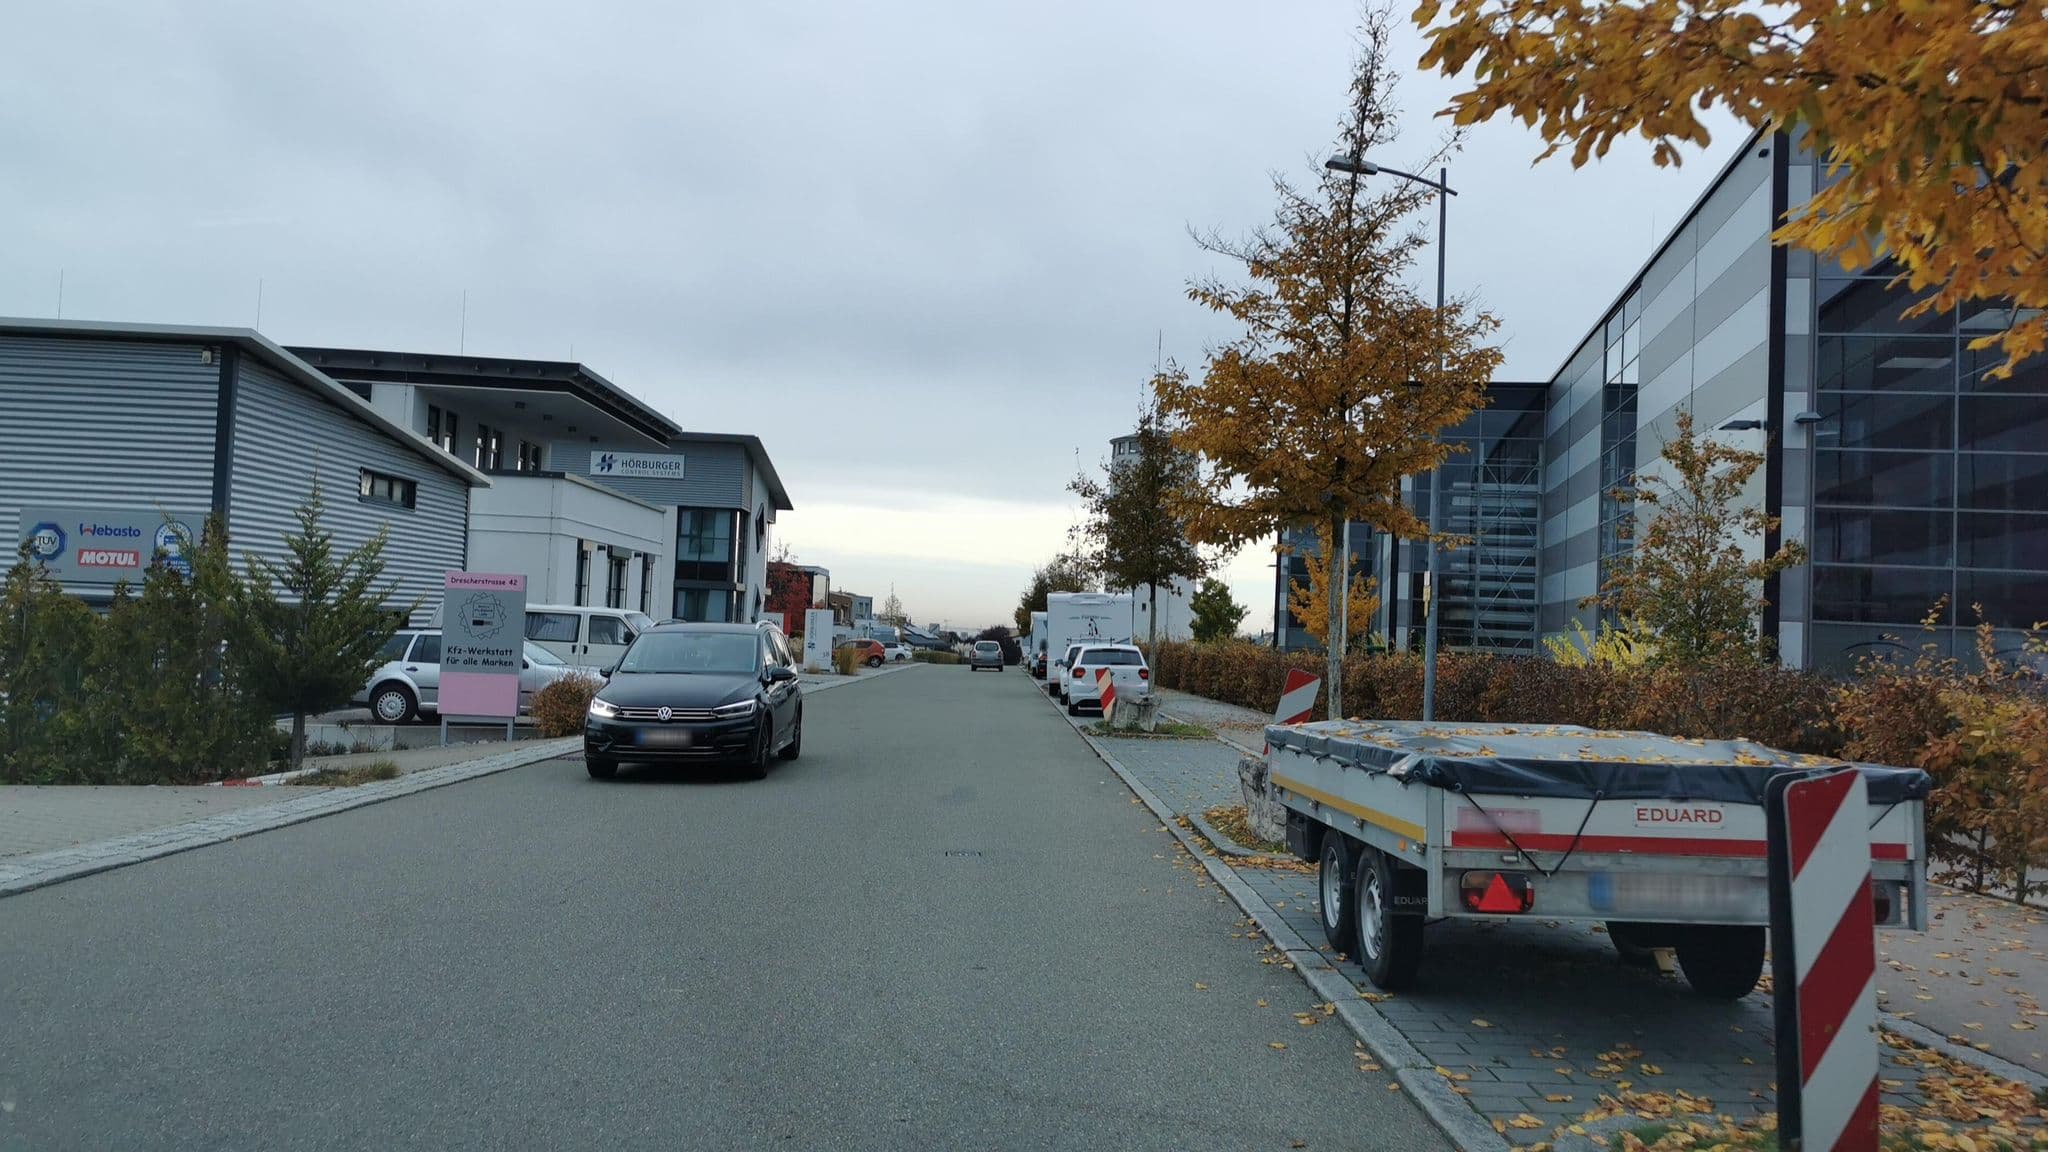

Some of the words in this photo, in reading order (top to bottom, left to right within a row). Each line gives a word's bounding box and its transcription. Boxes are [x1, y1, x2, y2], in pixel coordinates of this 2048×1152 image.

[621, 457, 681, 470] HÖRBURGER
[621, 468, 650, 476] CONTROL
[79, 523, 141, 537] Webasto
[37, 535, 57, 546] TÜV
[80, 551, 137, 566] MOTUL
[450, 576, 506, 586] Drescherstrasse
[508, 578, 518, 586] 42
[447, 646, 513, 656] Kfz-Werkstatt
[446, 656, 460, 665] für
[463, 657, 478, 666] alle
[482, 658, 514, 667] Marken
[1636, 807, 1723, 823] EDUARD
[1394, 896, 1428, 905] EDUAR
